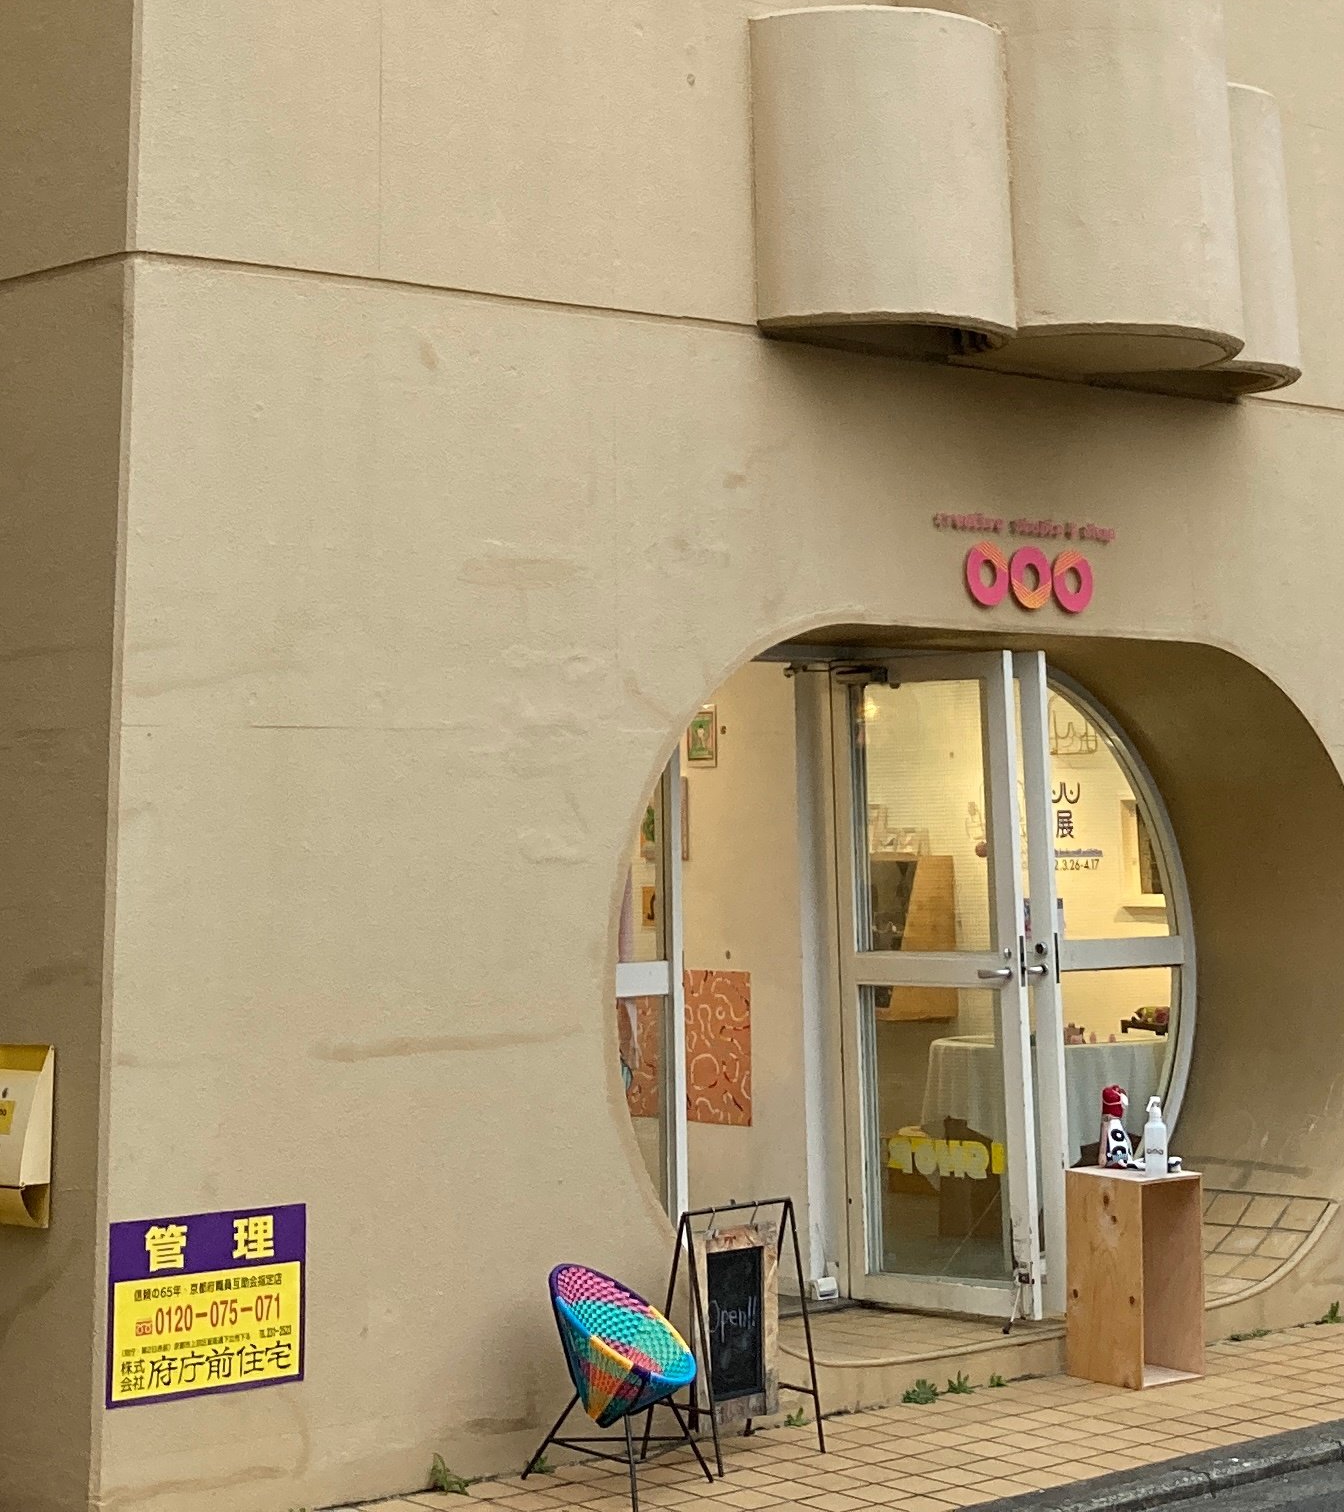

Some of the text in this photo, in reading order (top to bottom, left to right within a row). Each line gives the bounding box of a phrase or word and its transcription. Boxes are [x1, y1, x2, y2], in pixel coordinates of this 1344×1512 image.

[144, 1214, 275, 1273] 管理
[155, 1292, 281, 1335] 0120-075-071
[120, 1358, 146, 1376] 株式
[120, 1375, 146, 1393] 会社
[147, 1340, 293, 1389] 府庁前住宅
